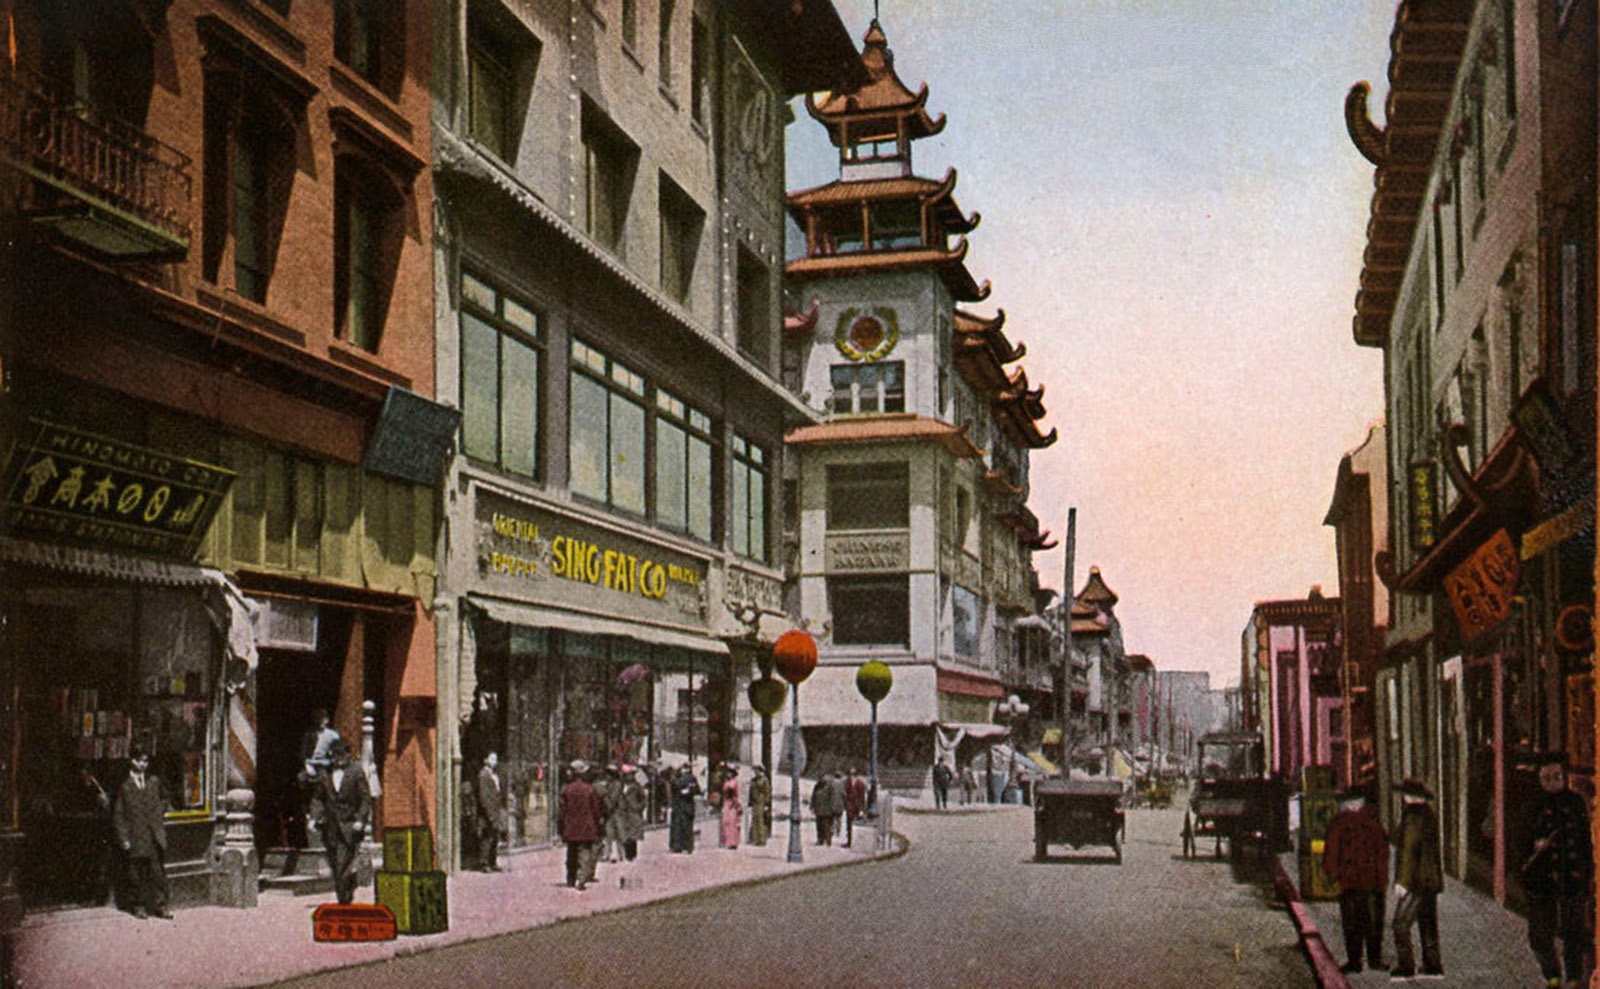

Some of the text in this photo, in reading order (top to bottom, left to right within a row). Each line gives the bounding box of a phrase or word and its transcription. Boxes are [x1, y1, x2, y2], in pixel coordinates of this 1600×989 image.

[551, 535, 600, 585] SING
[604, 549, 637, 593] FAT
[639, 560, 667, 599] CO
